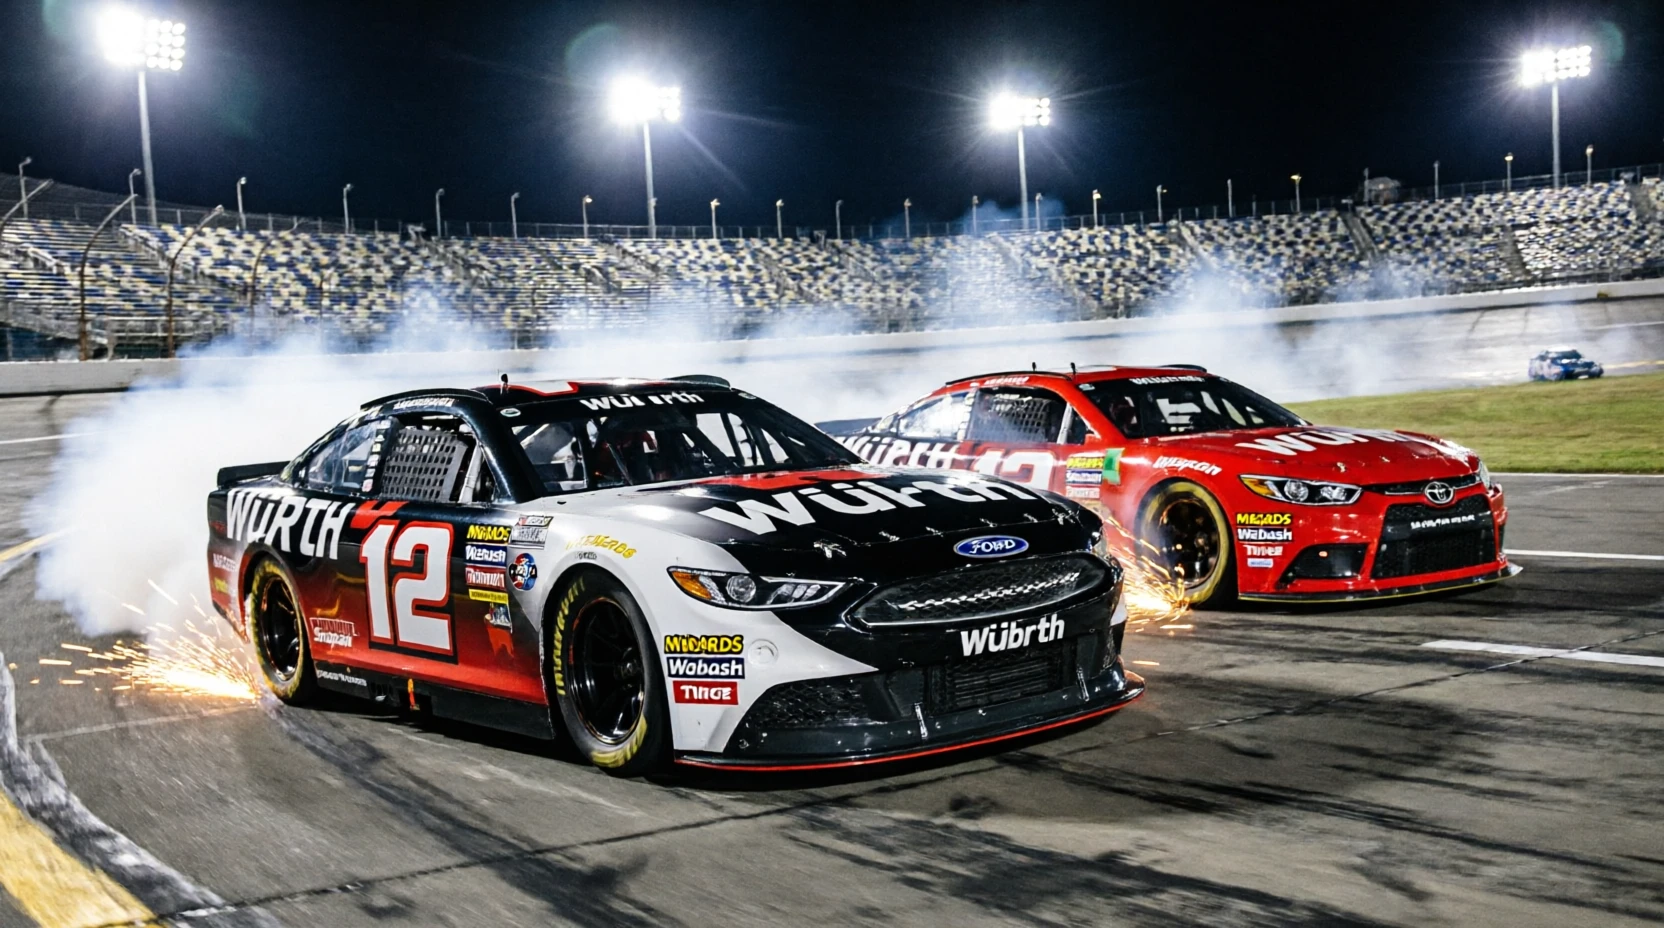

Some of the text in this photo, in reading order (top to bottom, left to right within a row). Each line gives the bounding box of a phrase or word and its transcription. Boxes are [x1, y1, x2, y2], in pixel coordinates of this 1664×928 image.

[359, 519, 457, 656] 12
[960, 613, 1065, 657] Wübrth
[669, 658, 743, 676] Wabash
